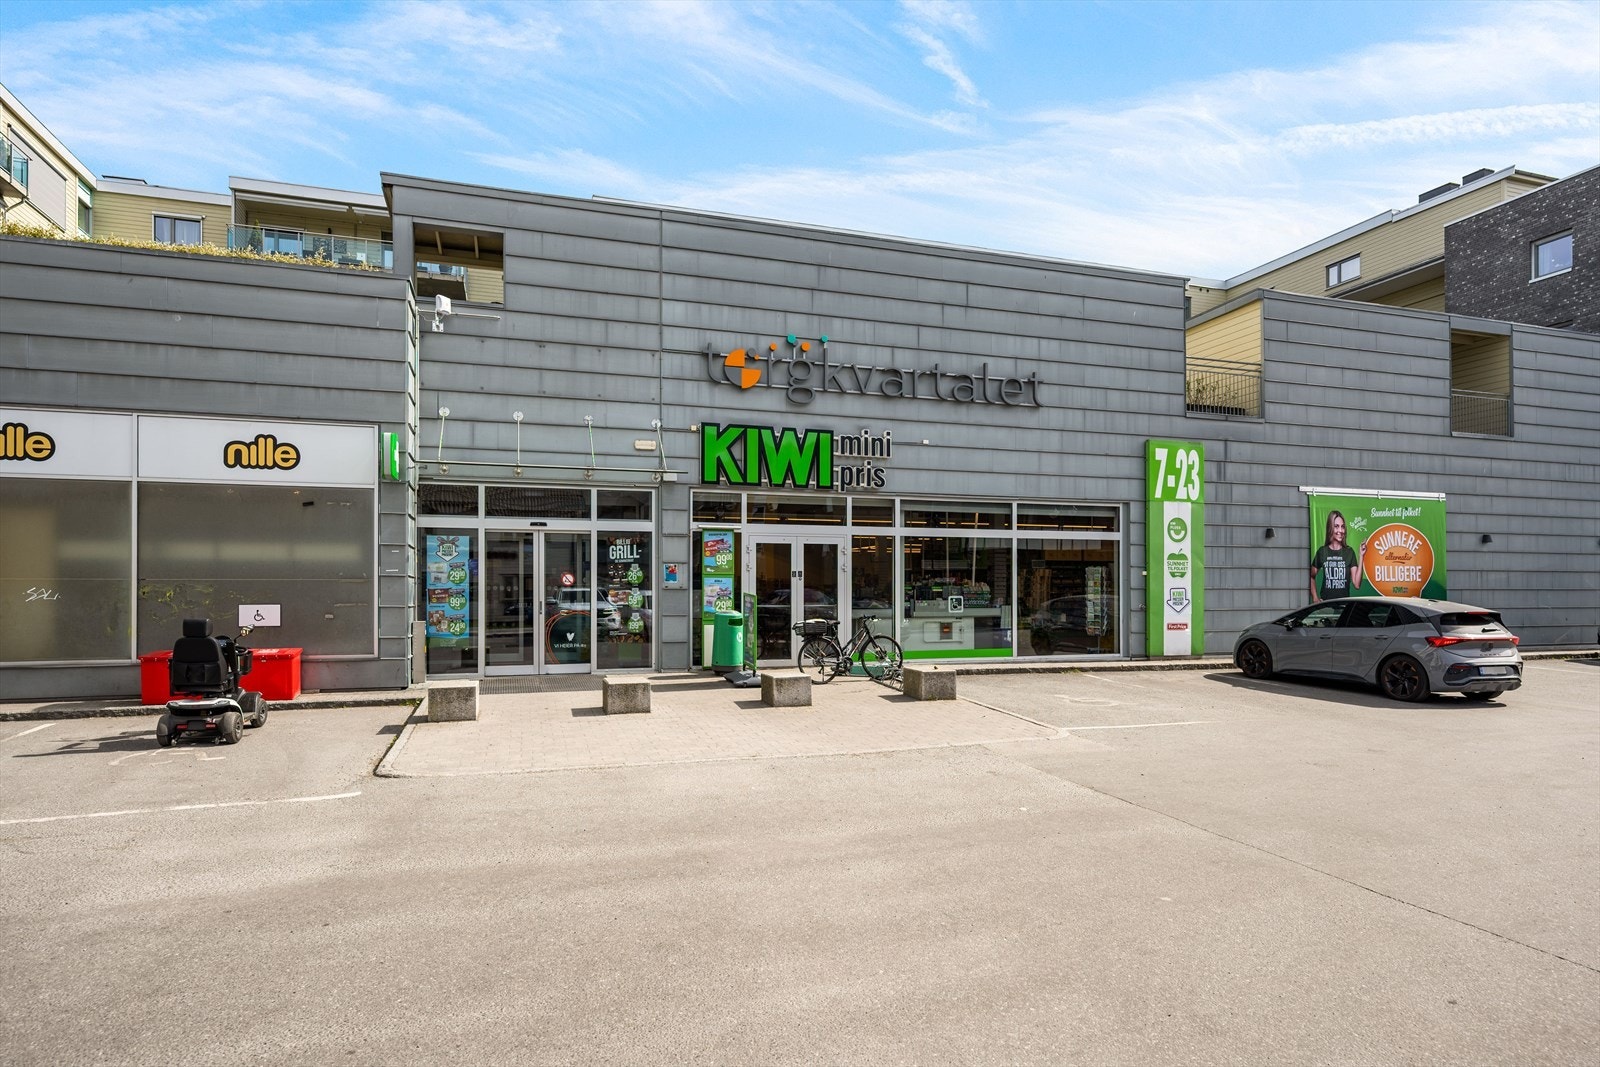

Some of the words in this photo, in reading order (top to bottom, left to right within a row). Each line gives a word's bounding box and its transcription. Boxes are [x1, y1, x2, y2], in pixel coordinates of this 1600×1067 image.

[703, 335, 1044, 407] torgkvartalet
[225, 435, 300, 469] nille
[701, 422, 834, 489] KIWI
[839, 429, 893, 458] mini
[839, 460, 887, 492] pris
[1154, 447, 1200, 501] 7-23
[1370, 507, 1395, 518] Sunnhet
[1374, 530, 1423, 555] SUNNERE
[1325, 567, 1346, 580] ALDRI
[1375, 565, 1422, 582] BILLIGERE
